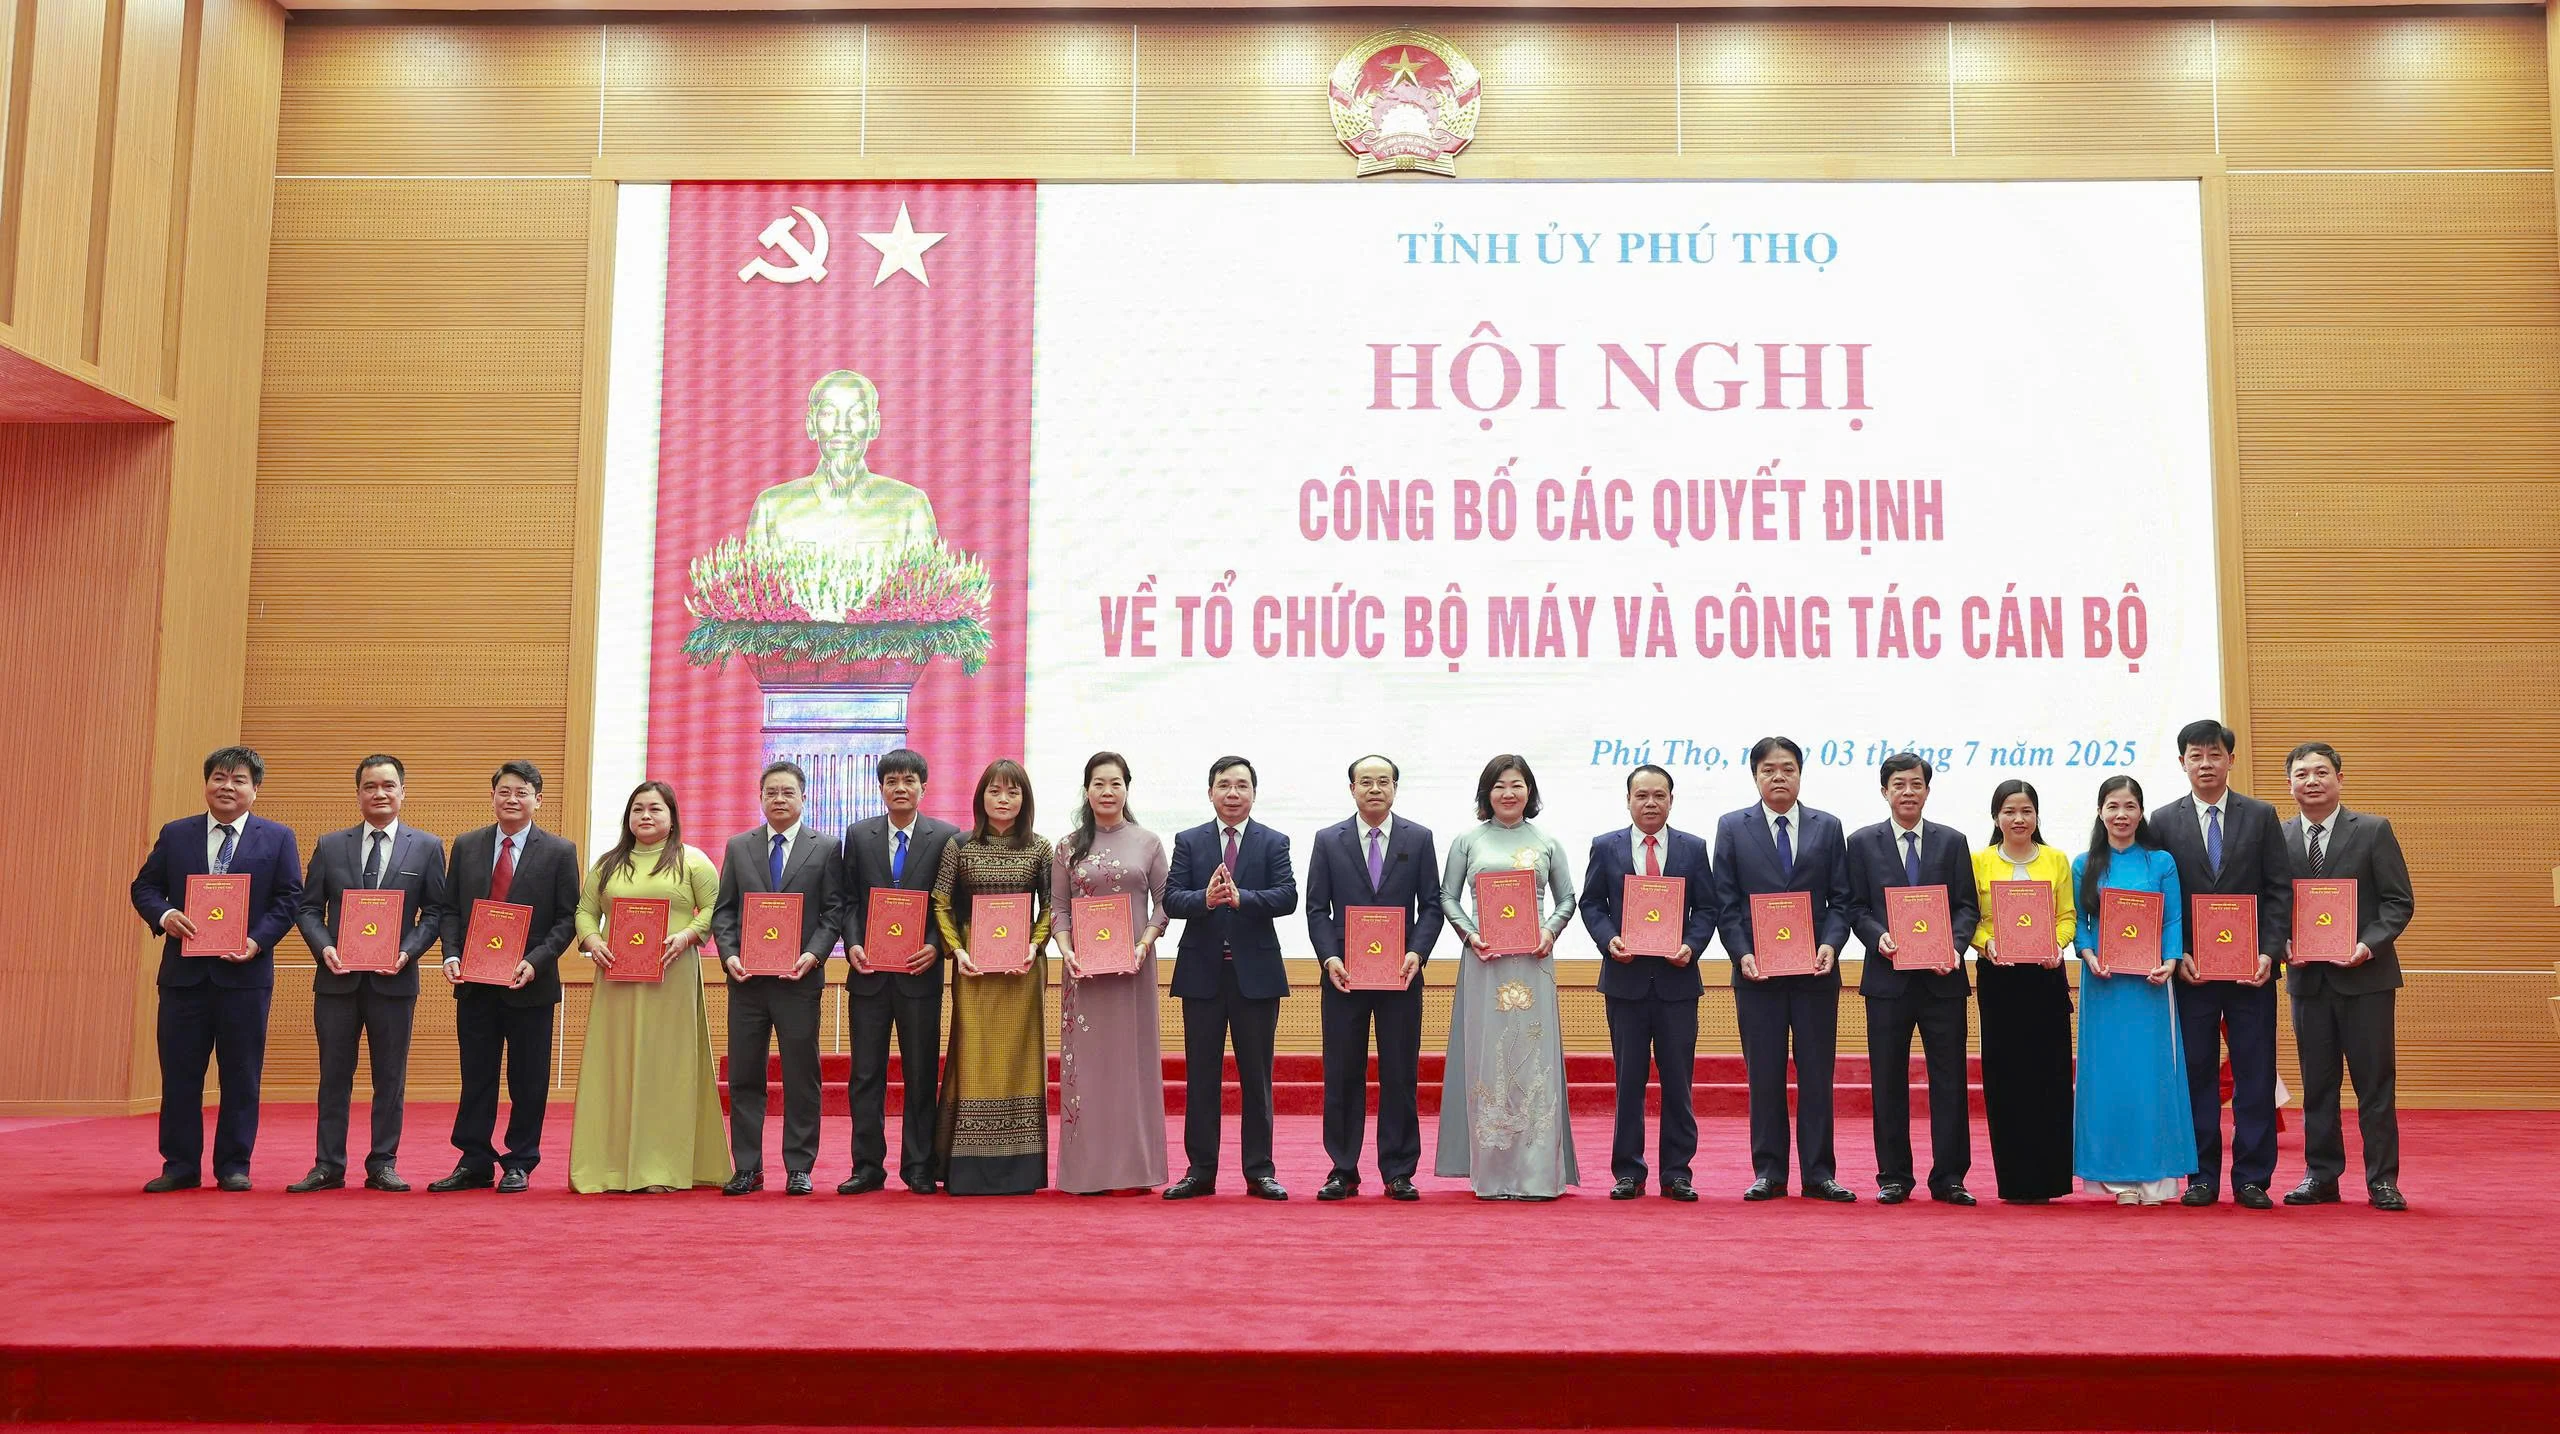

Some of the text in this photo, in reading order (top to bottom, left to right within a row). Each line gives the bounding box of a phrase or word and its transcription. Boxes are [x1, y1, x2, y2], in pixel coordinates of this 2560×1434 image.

[1397, 222, 1838, 273] TỈNH ỦY PHÚ THỌ
[1367, 321, 1873, 431] HỘI NGHỊ
[1300, 457, 1944, 556] CÔNG BỐ CÁC QUYẾT ĐỊNH
[1100, 570, 2148, 673] VỀ TỔ CHỨC BỘ MÁY VÀ CÔNG TÁC CÁN BỘ
[1590, 739, 1650, 766] Phú
[1663, 739, 1729, 771] Thọ,
[1820, 739, 1855, 766] 03
[1966, 740, 1980, 765] 7
[1990, 737, 2054, 767] năm
[2065, 739, 2137, 767] 2025
